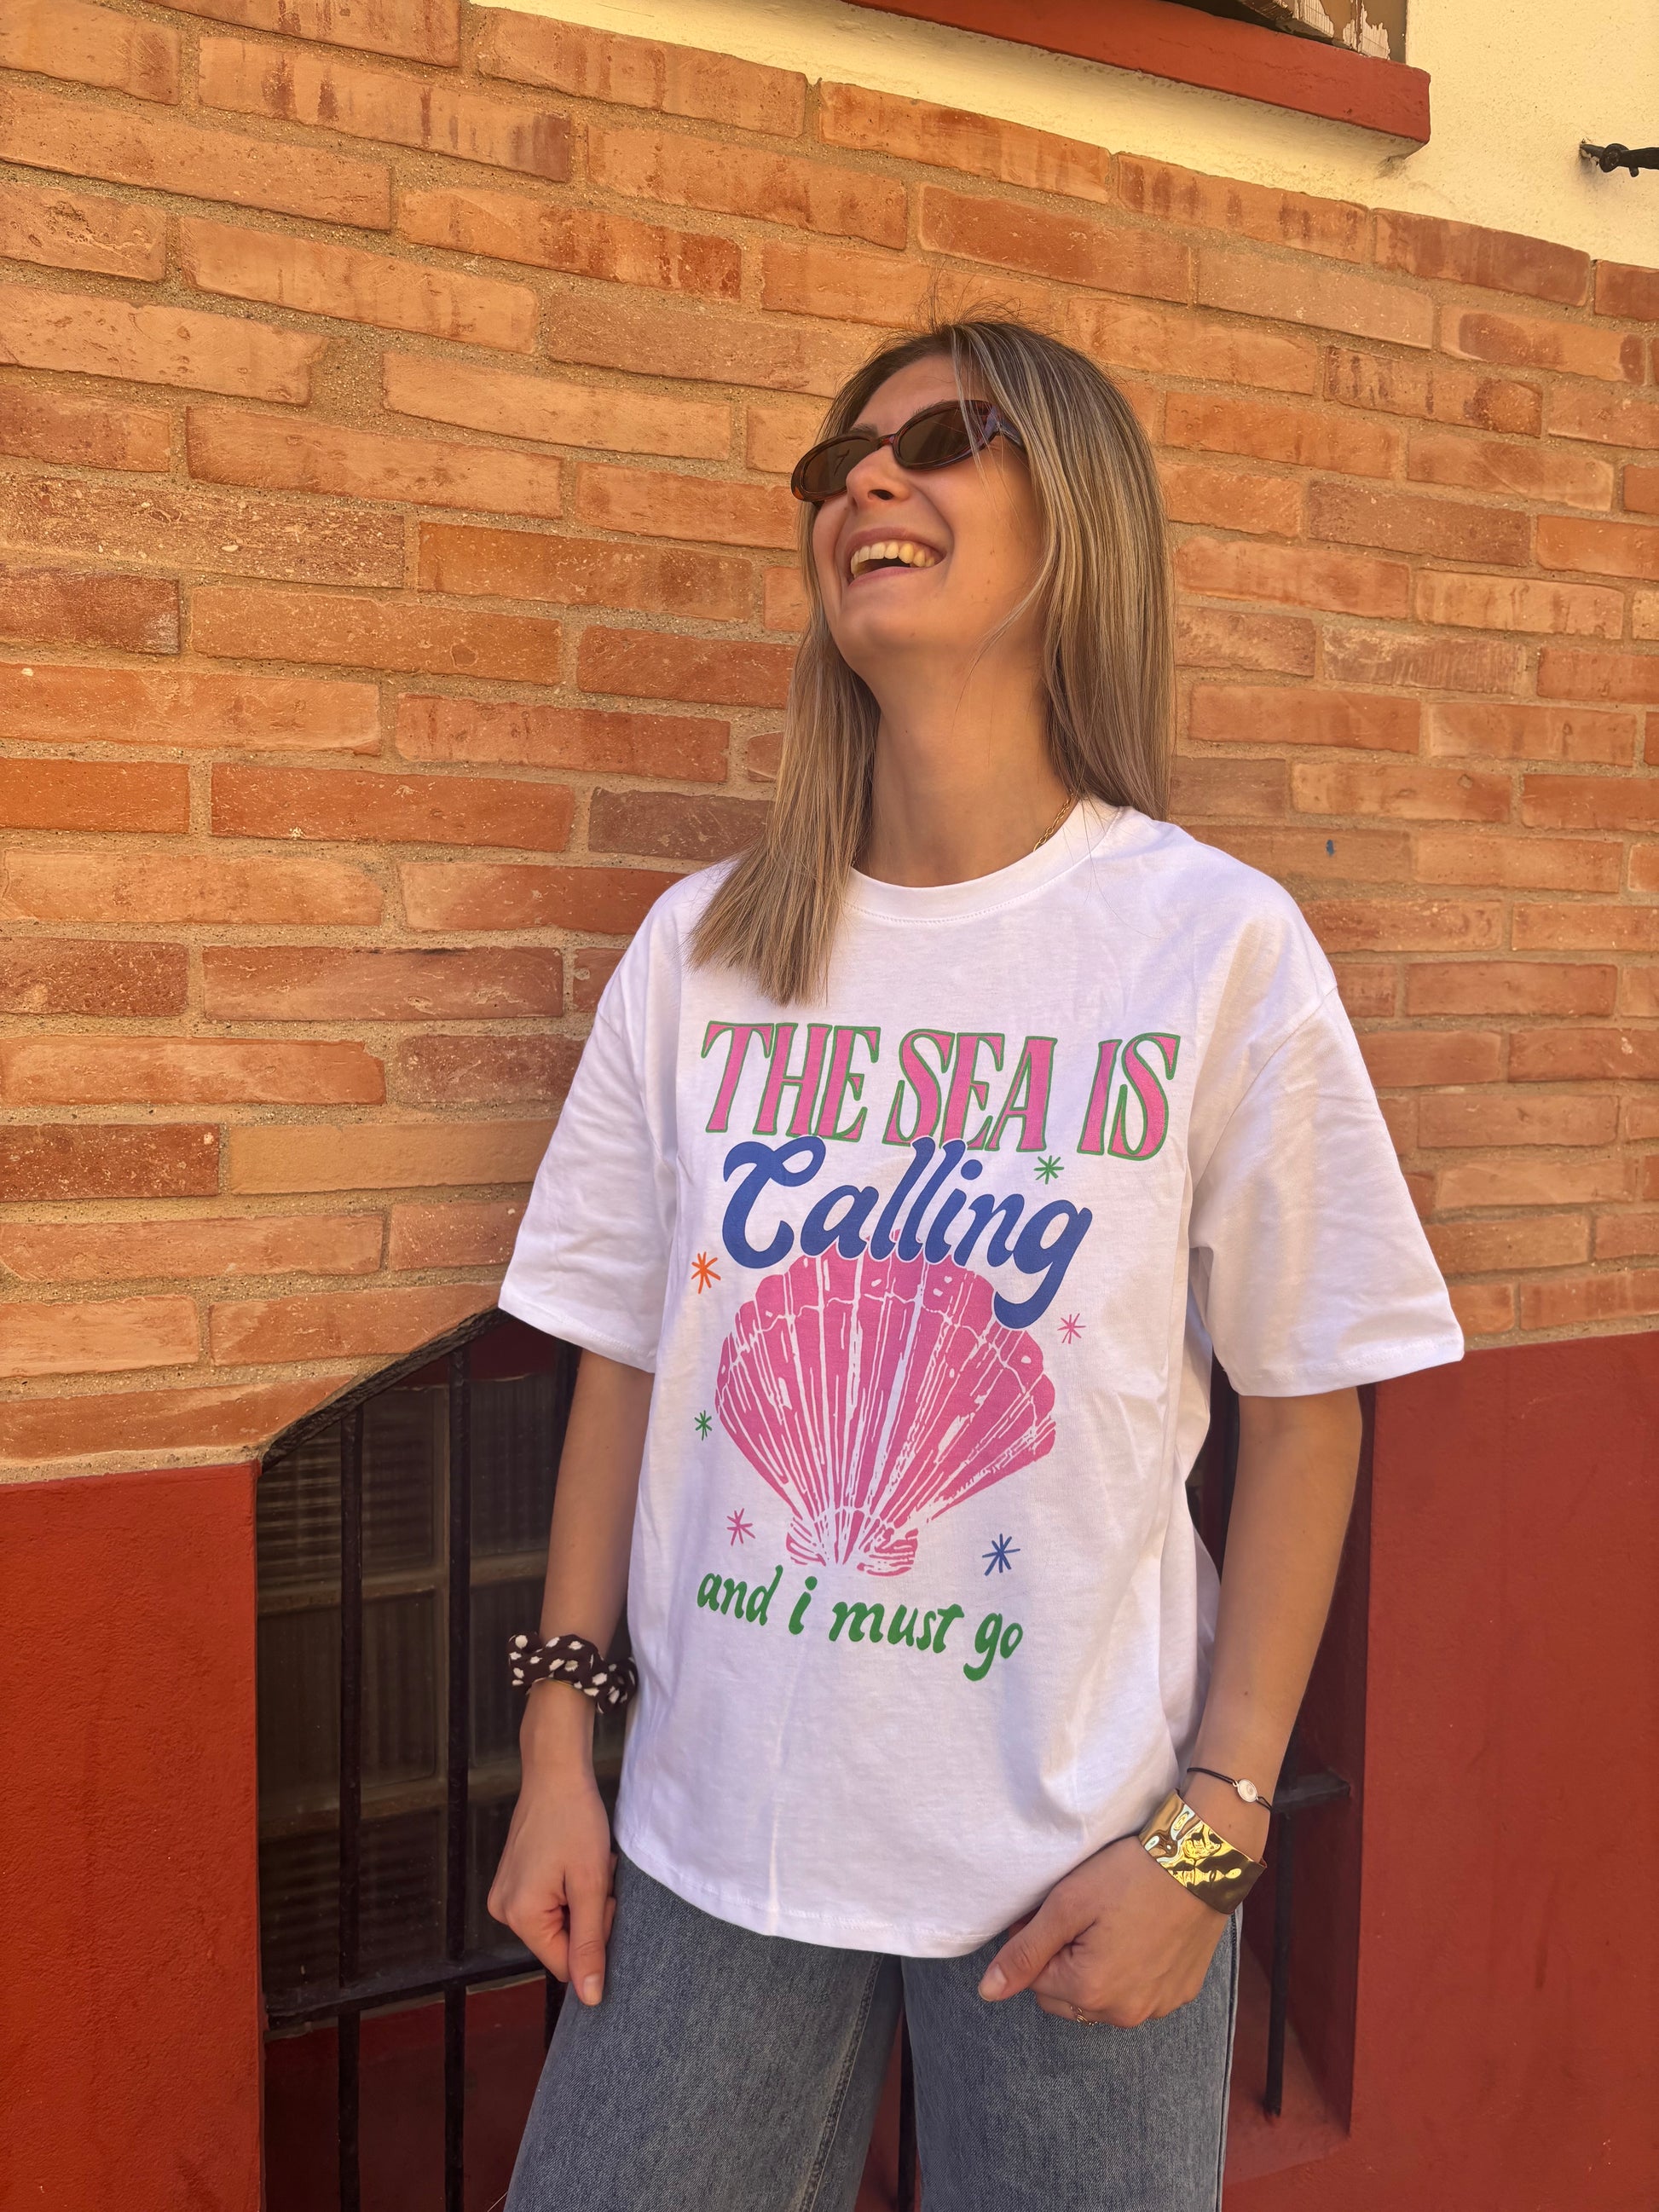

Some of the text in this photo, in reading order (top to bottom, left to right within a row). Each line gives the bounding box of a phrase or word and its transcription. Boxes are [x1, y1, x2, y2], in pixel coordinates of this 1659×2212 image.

[701, 1020, 1181, 1161] THE SEA IS
[722, 1136, 1093, 1329] Calling
[697, 1564, 1023, 1681] and i must go
